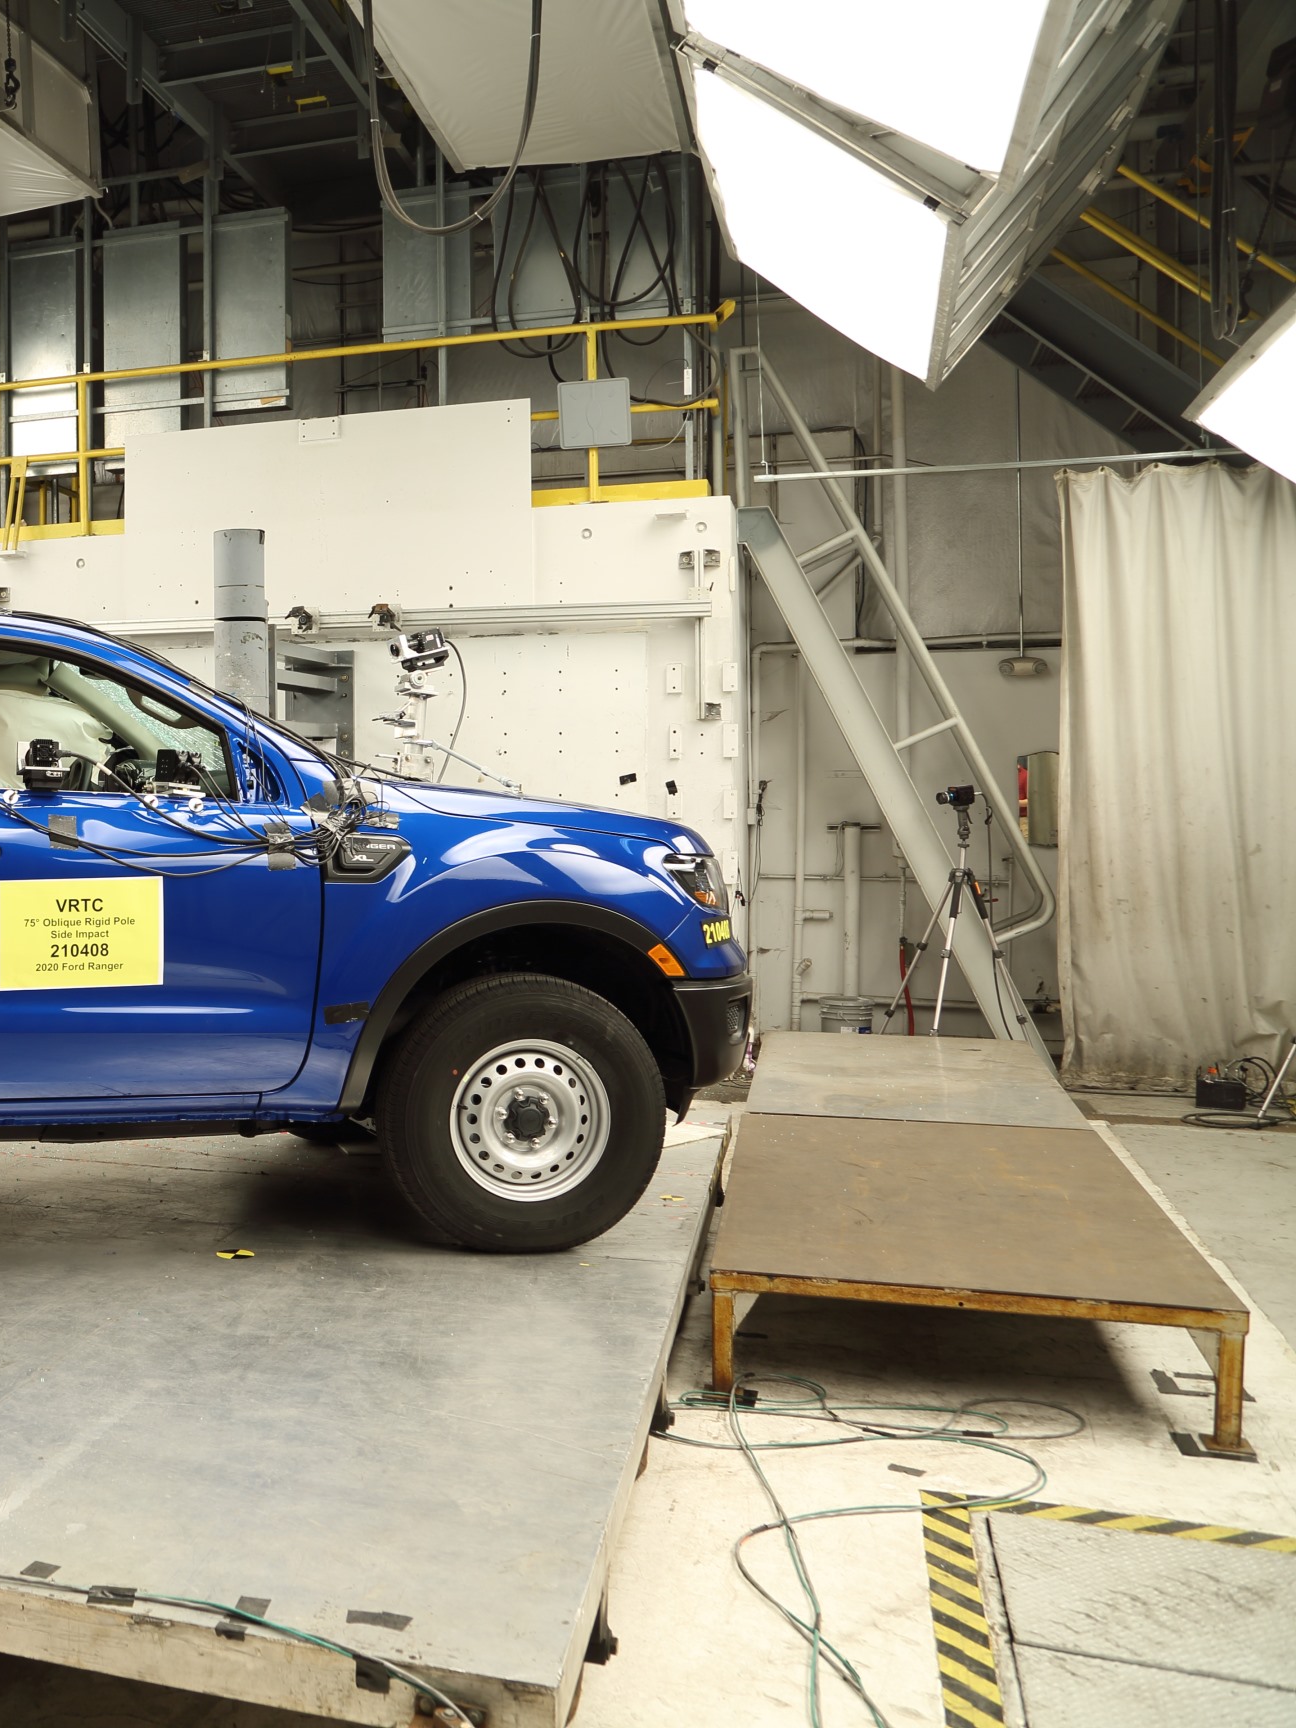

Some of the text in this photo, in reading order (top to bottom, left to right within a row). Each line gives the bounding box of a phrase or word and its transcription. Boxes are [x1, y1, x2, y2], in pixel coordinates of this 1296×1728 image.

[351, 854, 374, 862] XL
[56, 898, 103, 912] VRTC
[24, 916, 135, 928] 75° Oblique Rigid Pole
[50, 929, 109, 940] Side Impact
[50, 943, 109, 958] 210408
[35, 961, 123, 973] 2020 Ford Ranger
